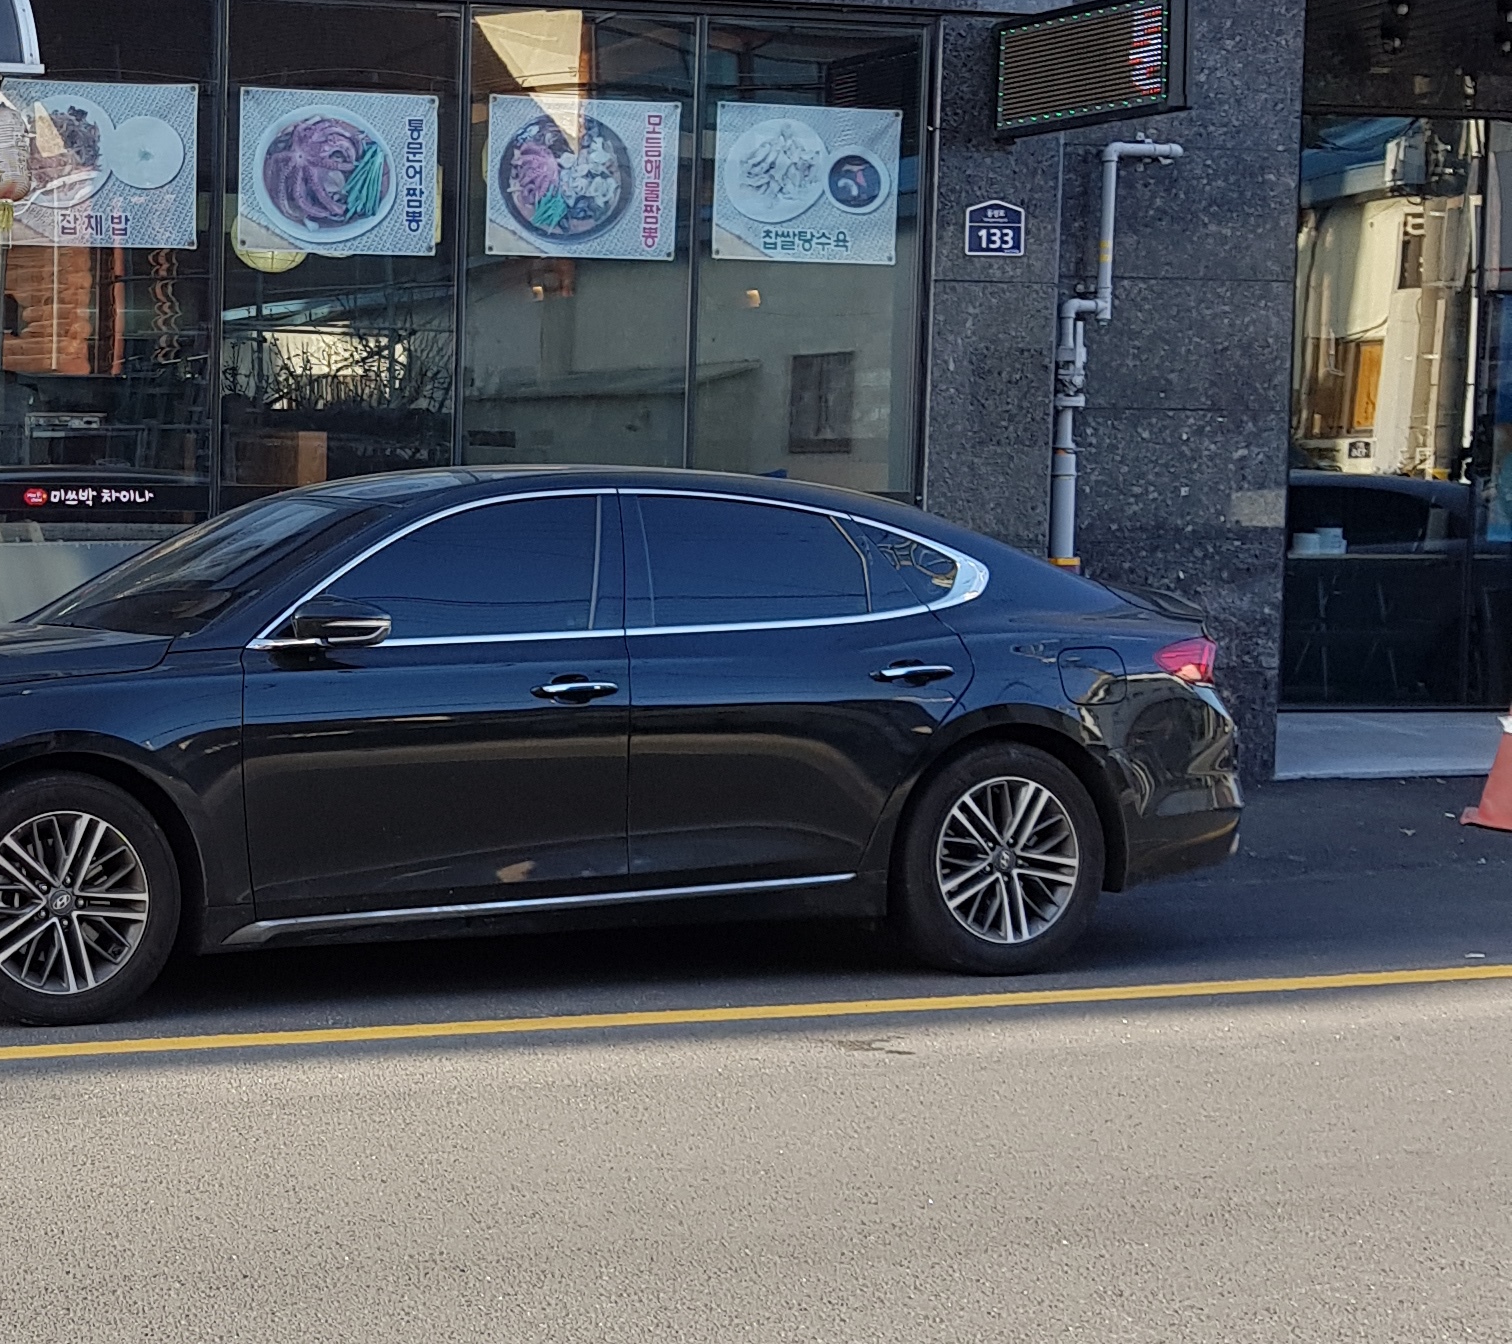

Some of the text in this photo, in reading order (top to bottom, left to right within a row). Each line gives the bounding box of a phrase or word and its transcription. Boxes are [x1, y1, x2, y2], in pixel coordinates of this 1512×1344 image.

[405, 118, 425, 234] 통문어짬뽕
[641, 114, 664, 249] 모듬해물짬뽕
[59, 212, 131, 237] 잡채밥
[761, 228, 850, 253] 찹쌀탕수육
[977, 228, 1014, 249] 133
[49, 487, 98, 506] 미쓰박
[101, 489, 155, 503] 차이나
